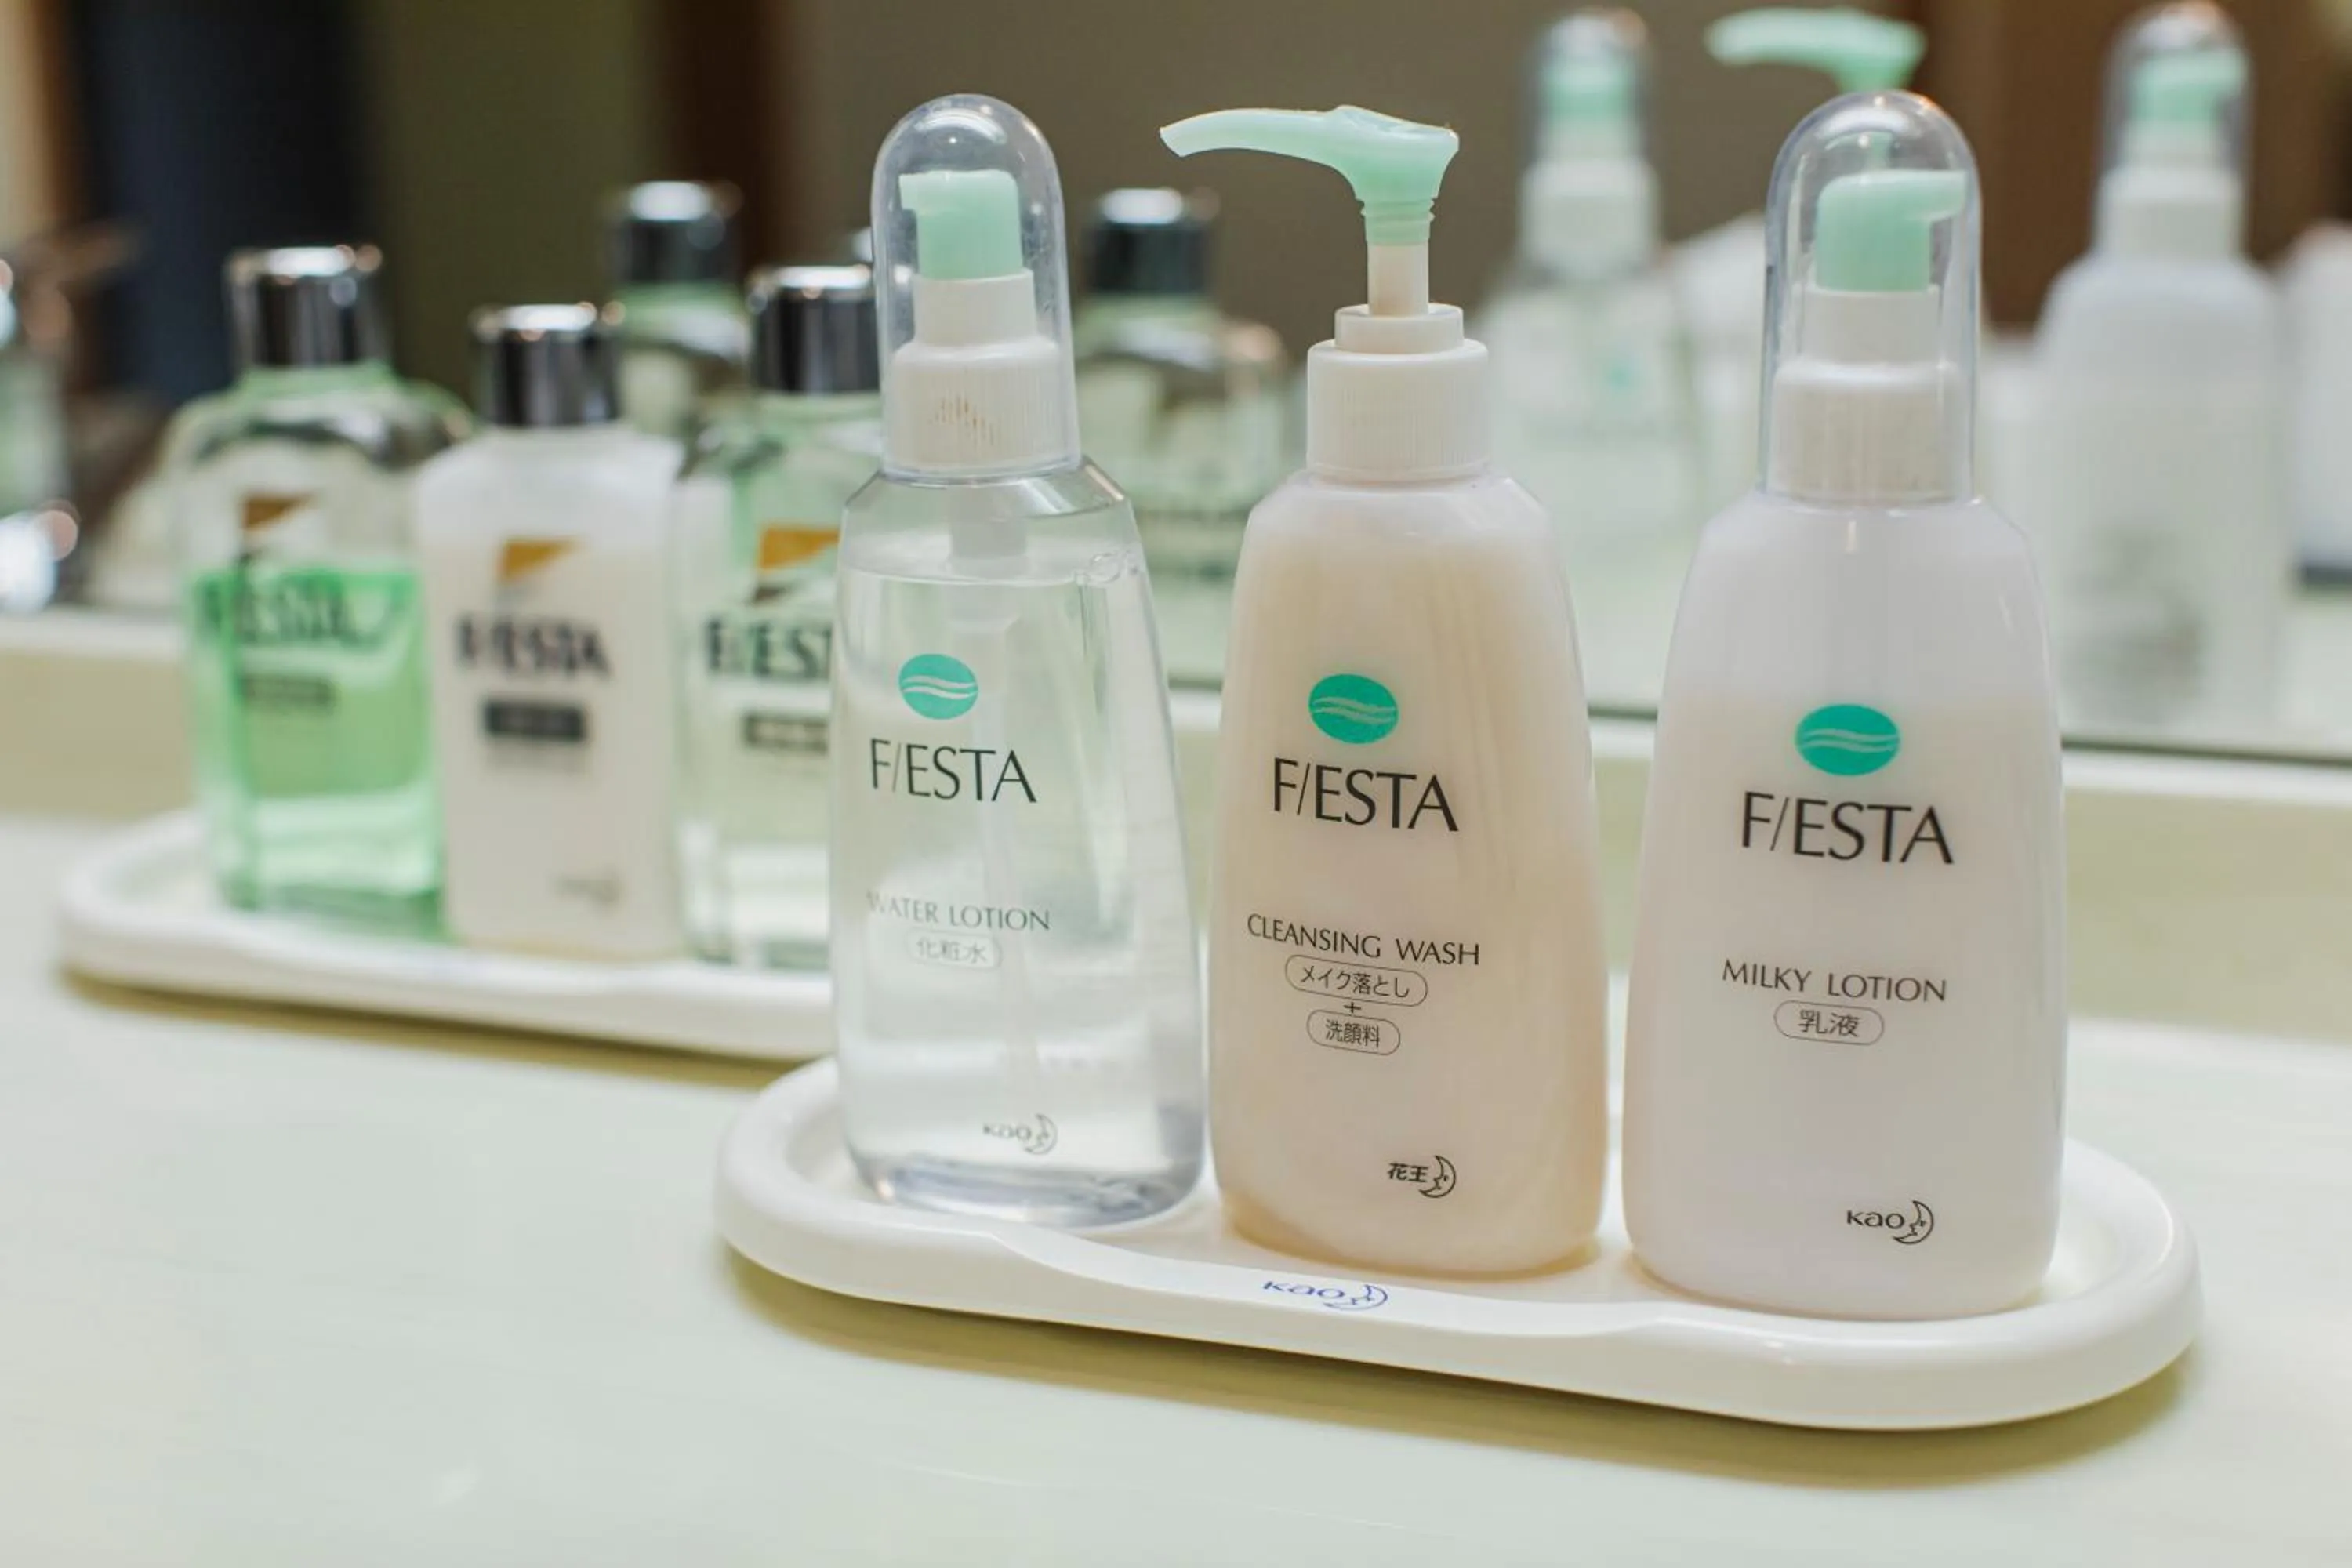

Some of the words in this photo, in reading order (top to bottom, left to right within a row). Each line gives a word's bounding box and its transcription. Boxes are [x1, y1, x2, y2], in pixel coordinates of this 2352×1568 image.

[949, 906, 1051, 931] LOTION
[916, 937, 988, 964] 化粧水
[1247, 913, 1382, 958] CLEANSING
[1396, 938, 1480, 966] WASH
[1300, 964, 1410, 999] メイク落とし
[1722, 959, 1813, 992] MILKY
[1827, 971, 1947, 1003] LOTION
[1325, 1019, 1381, 1048] 洗顔料
[1798, 1008, 1860, 1038] 乳液
[1387, 1162, 1428, 1183] 花王
[1846, 1210, 1906, 1229] kao
